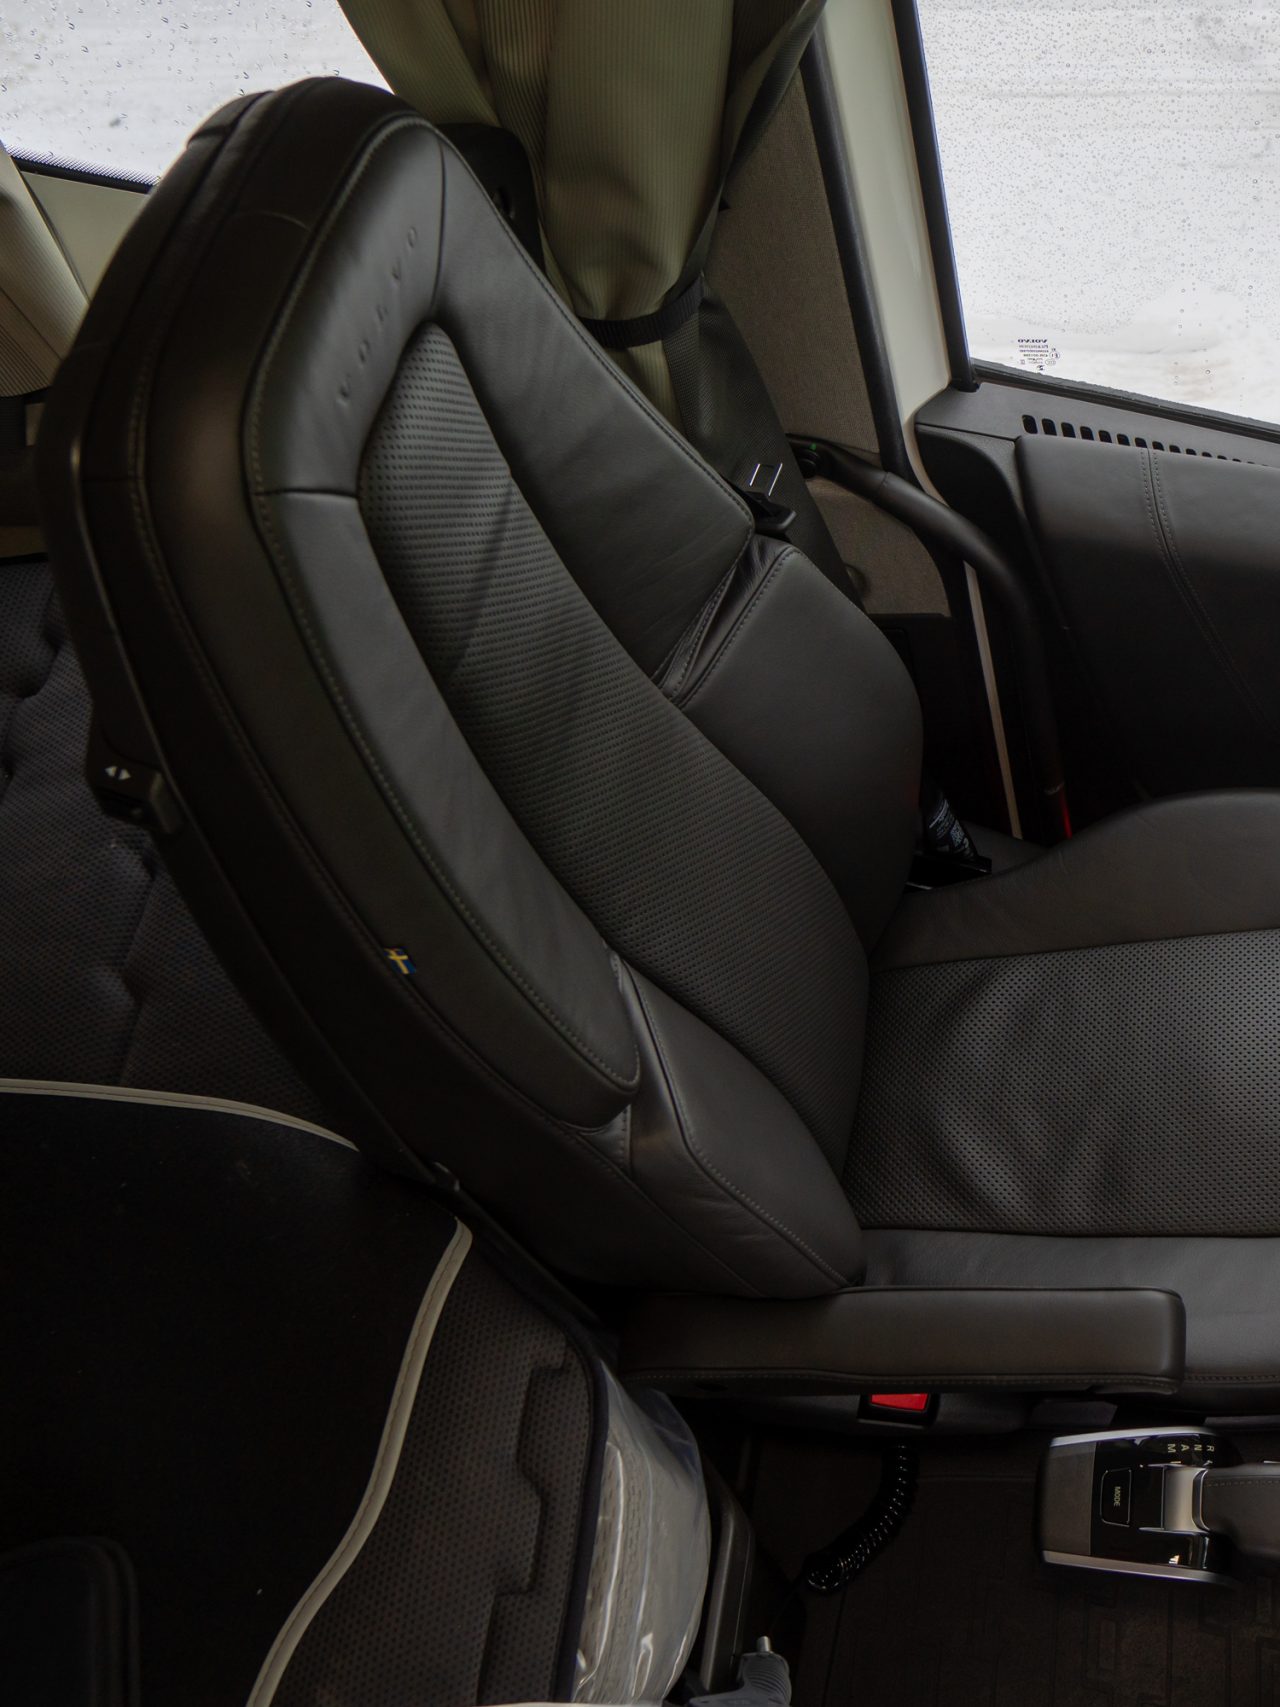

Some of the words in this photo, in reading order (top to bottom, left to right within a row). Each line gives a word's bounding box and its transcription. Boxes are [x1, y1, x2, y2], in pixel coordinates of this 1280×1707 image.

[1167, 1443, 1177, 1453] M
[1181, 1443, 1190, 1452] A
[1194, 1444, 1203, 1452] N
[1206, 1444, 1215, 1453] R
[1113, 1486, 1121, 1507] MODE
